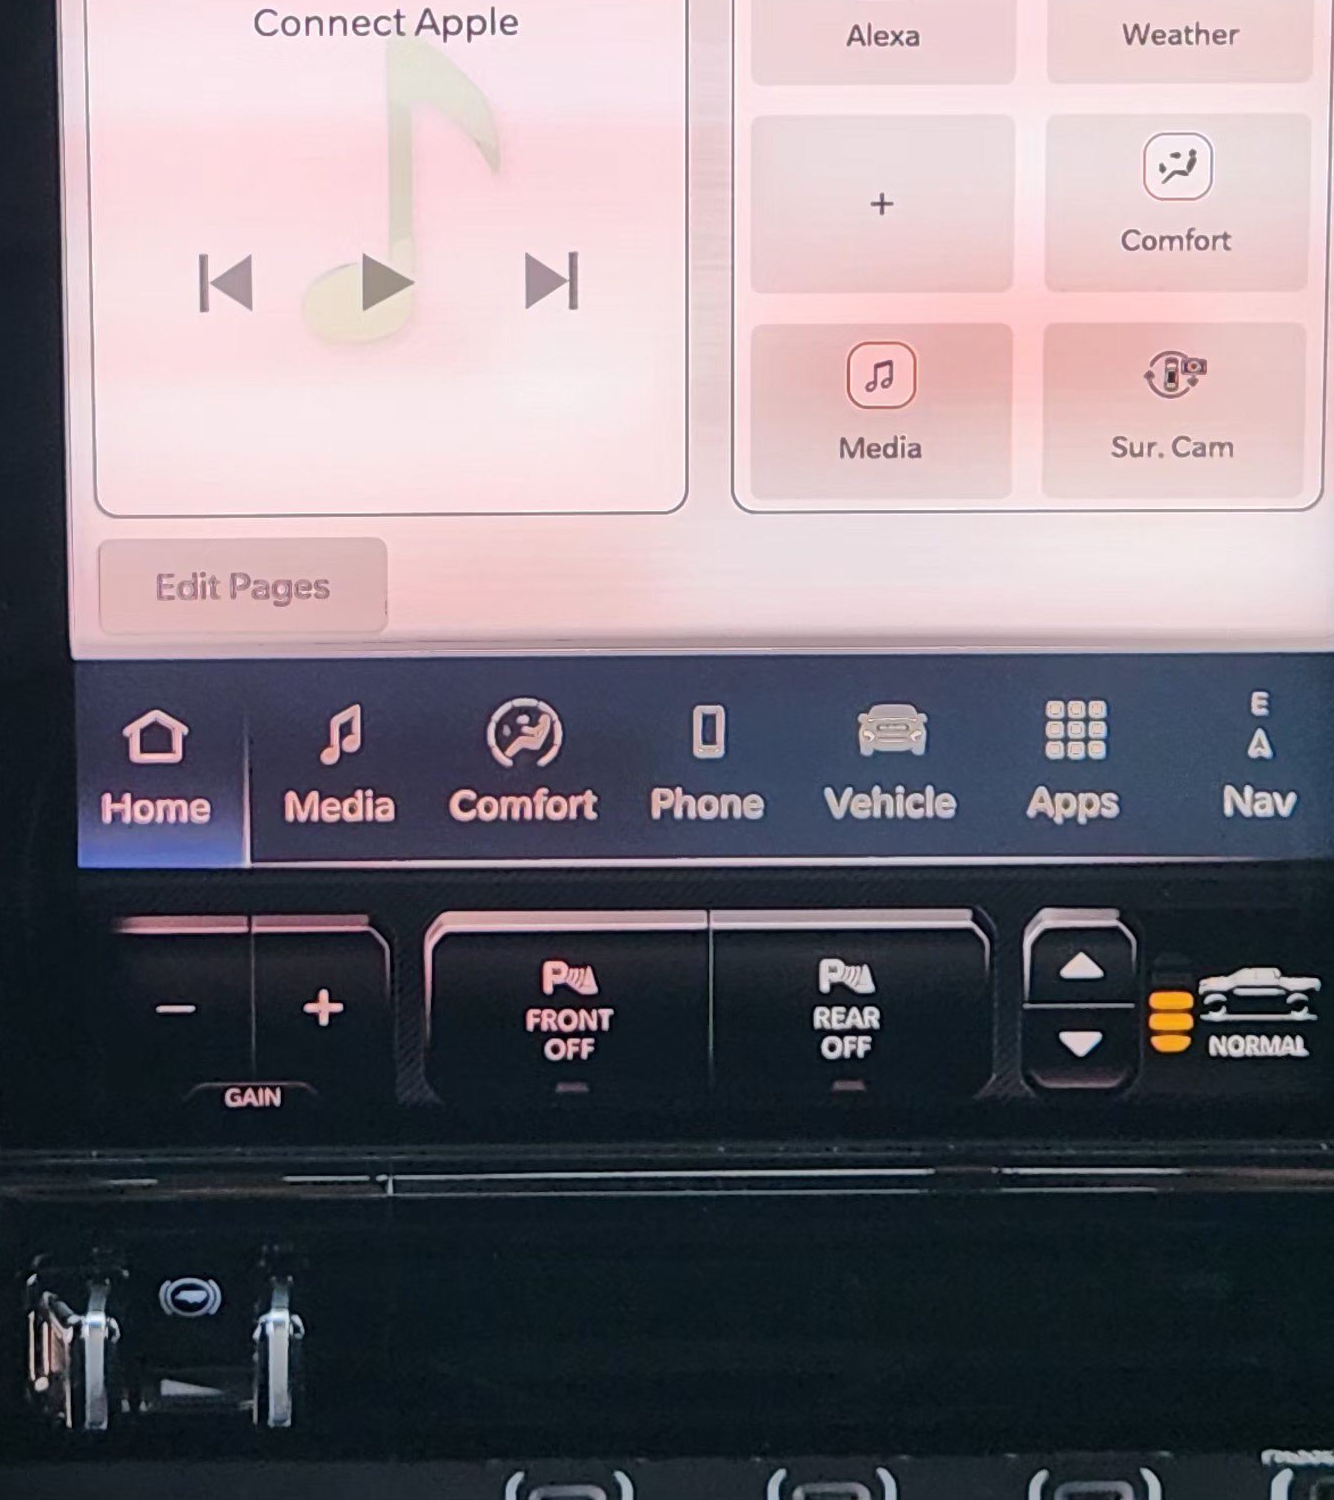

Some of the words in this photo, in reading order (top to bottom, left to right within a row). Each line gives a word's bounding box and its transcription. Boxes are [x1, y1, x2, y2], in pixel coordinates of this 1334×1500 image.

[253, 8, 407, 39] Connect
[415, 7, 520, 44] Apple
[846, 24, 921, 48] Alexa
[1122, 22, 1241, 47] Weather
[1121, 228, 1232, 253] Comfort
[839, 436, 922, 460] Media
[1111, 436, 1164, 460] Sur.
[1172, 436, 1234, 460] Cam
[156, 572, 221, 602] Edit
[229, 573, 331, 607] Pages
[1250, 691, 1270, 716] E
[101, 792, 211, 824] Home
[284, 789, 396, 823] Media
[450, 788, 598, 822] Comfort
[651, 787, 764, 821] Phone
[824, 785, 957, 820] Vehicle
[1027, 785, 1120, 825] Apps
[1223, 785, 1298, 819] Nav
[525, 1008, 614, 1032] FRONT
[813, 1006, 880, 1030] REAR
[544, 1038, 595, 1060] OFF
[821, 1036, 872, 1060] OFF
[1208, 1035, 1310, 1058] NORMAL
[224, 1087, 281, 1108] GAIN
